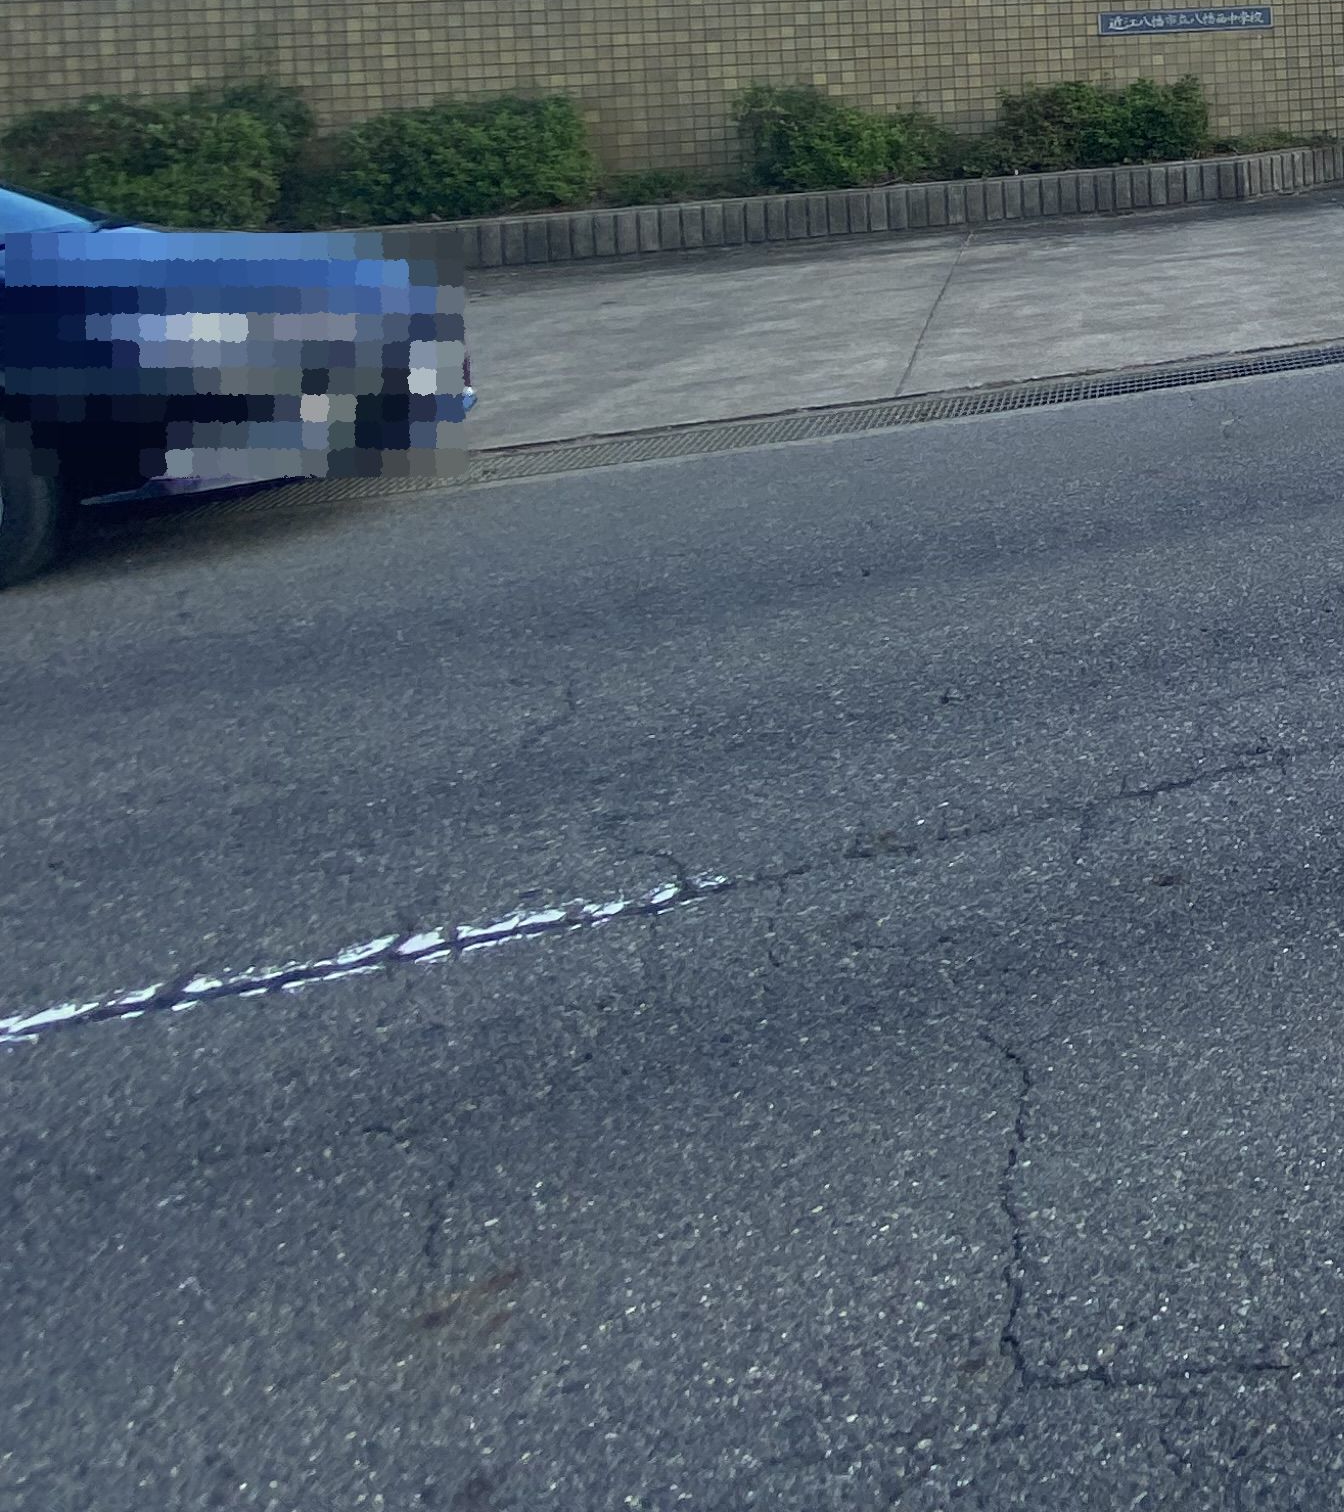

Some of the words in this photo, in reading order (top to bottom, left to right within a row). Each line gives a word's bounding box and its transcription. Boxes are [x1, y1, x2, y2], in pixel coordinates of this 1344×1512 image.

[1108, 11, 1265, 30] 近江八幡市立八幡西中学校
